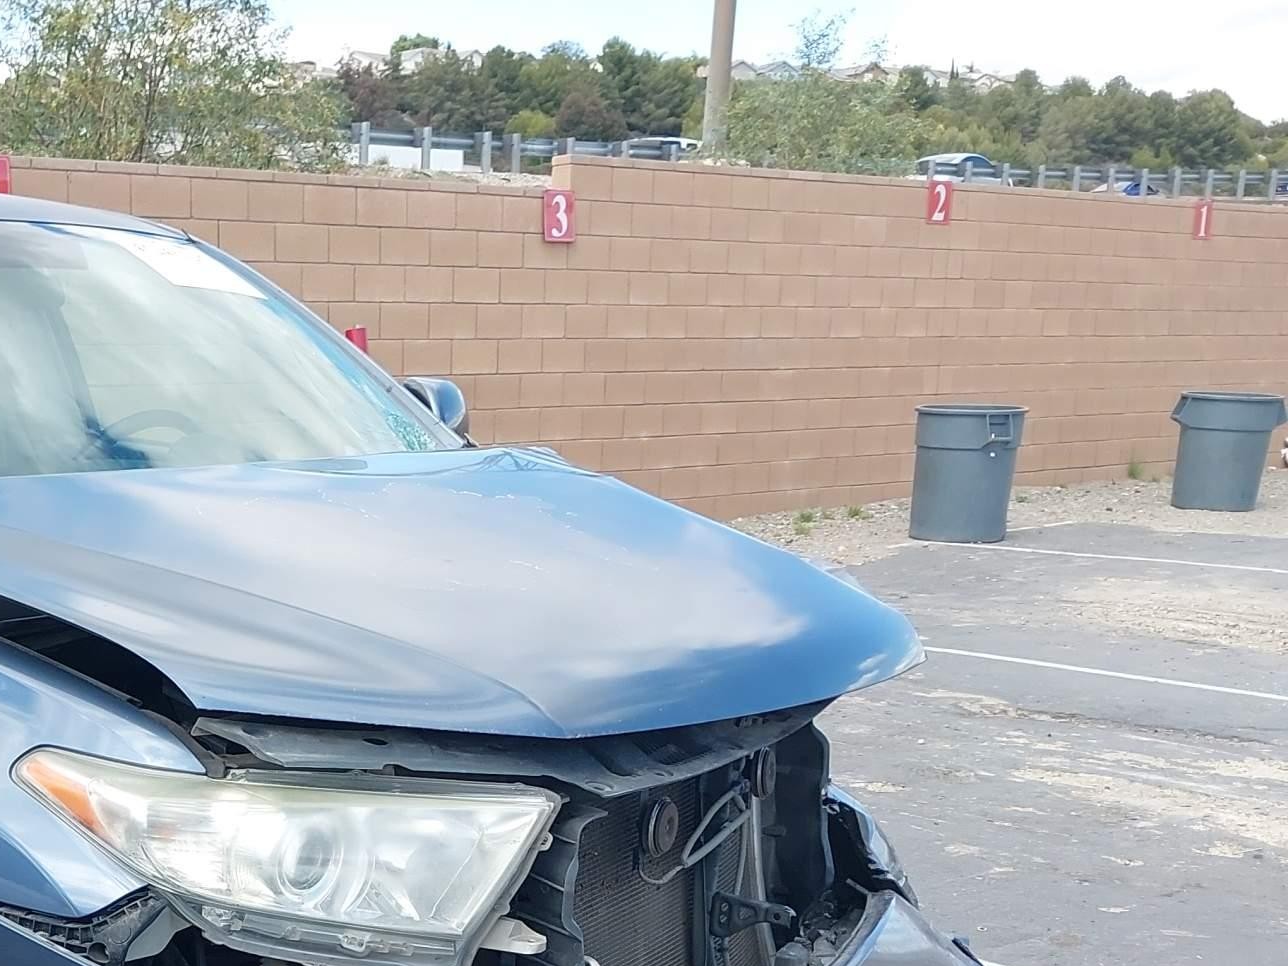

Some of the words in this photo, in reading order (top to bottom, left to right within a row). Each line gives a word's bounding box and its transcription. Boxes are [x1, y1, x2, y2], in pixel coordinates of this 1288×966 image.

[551, 194, 568, 237] 3
[931, 184, 947, 221] 2
[1197, 205, 1208, 237] 1
